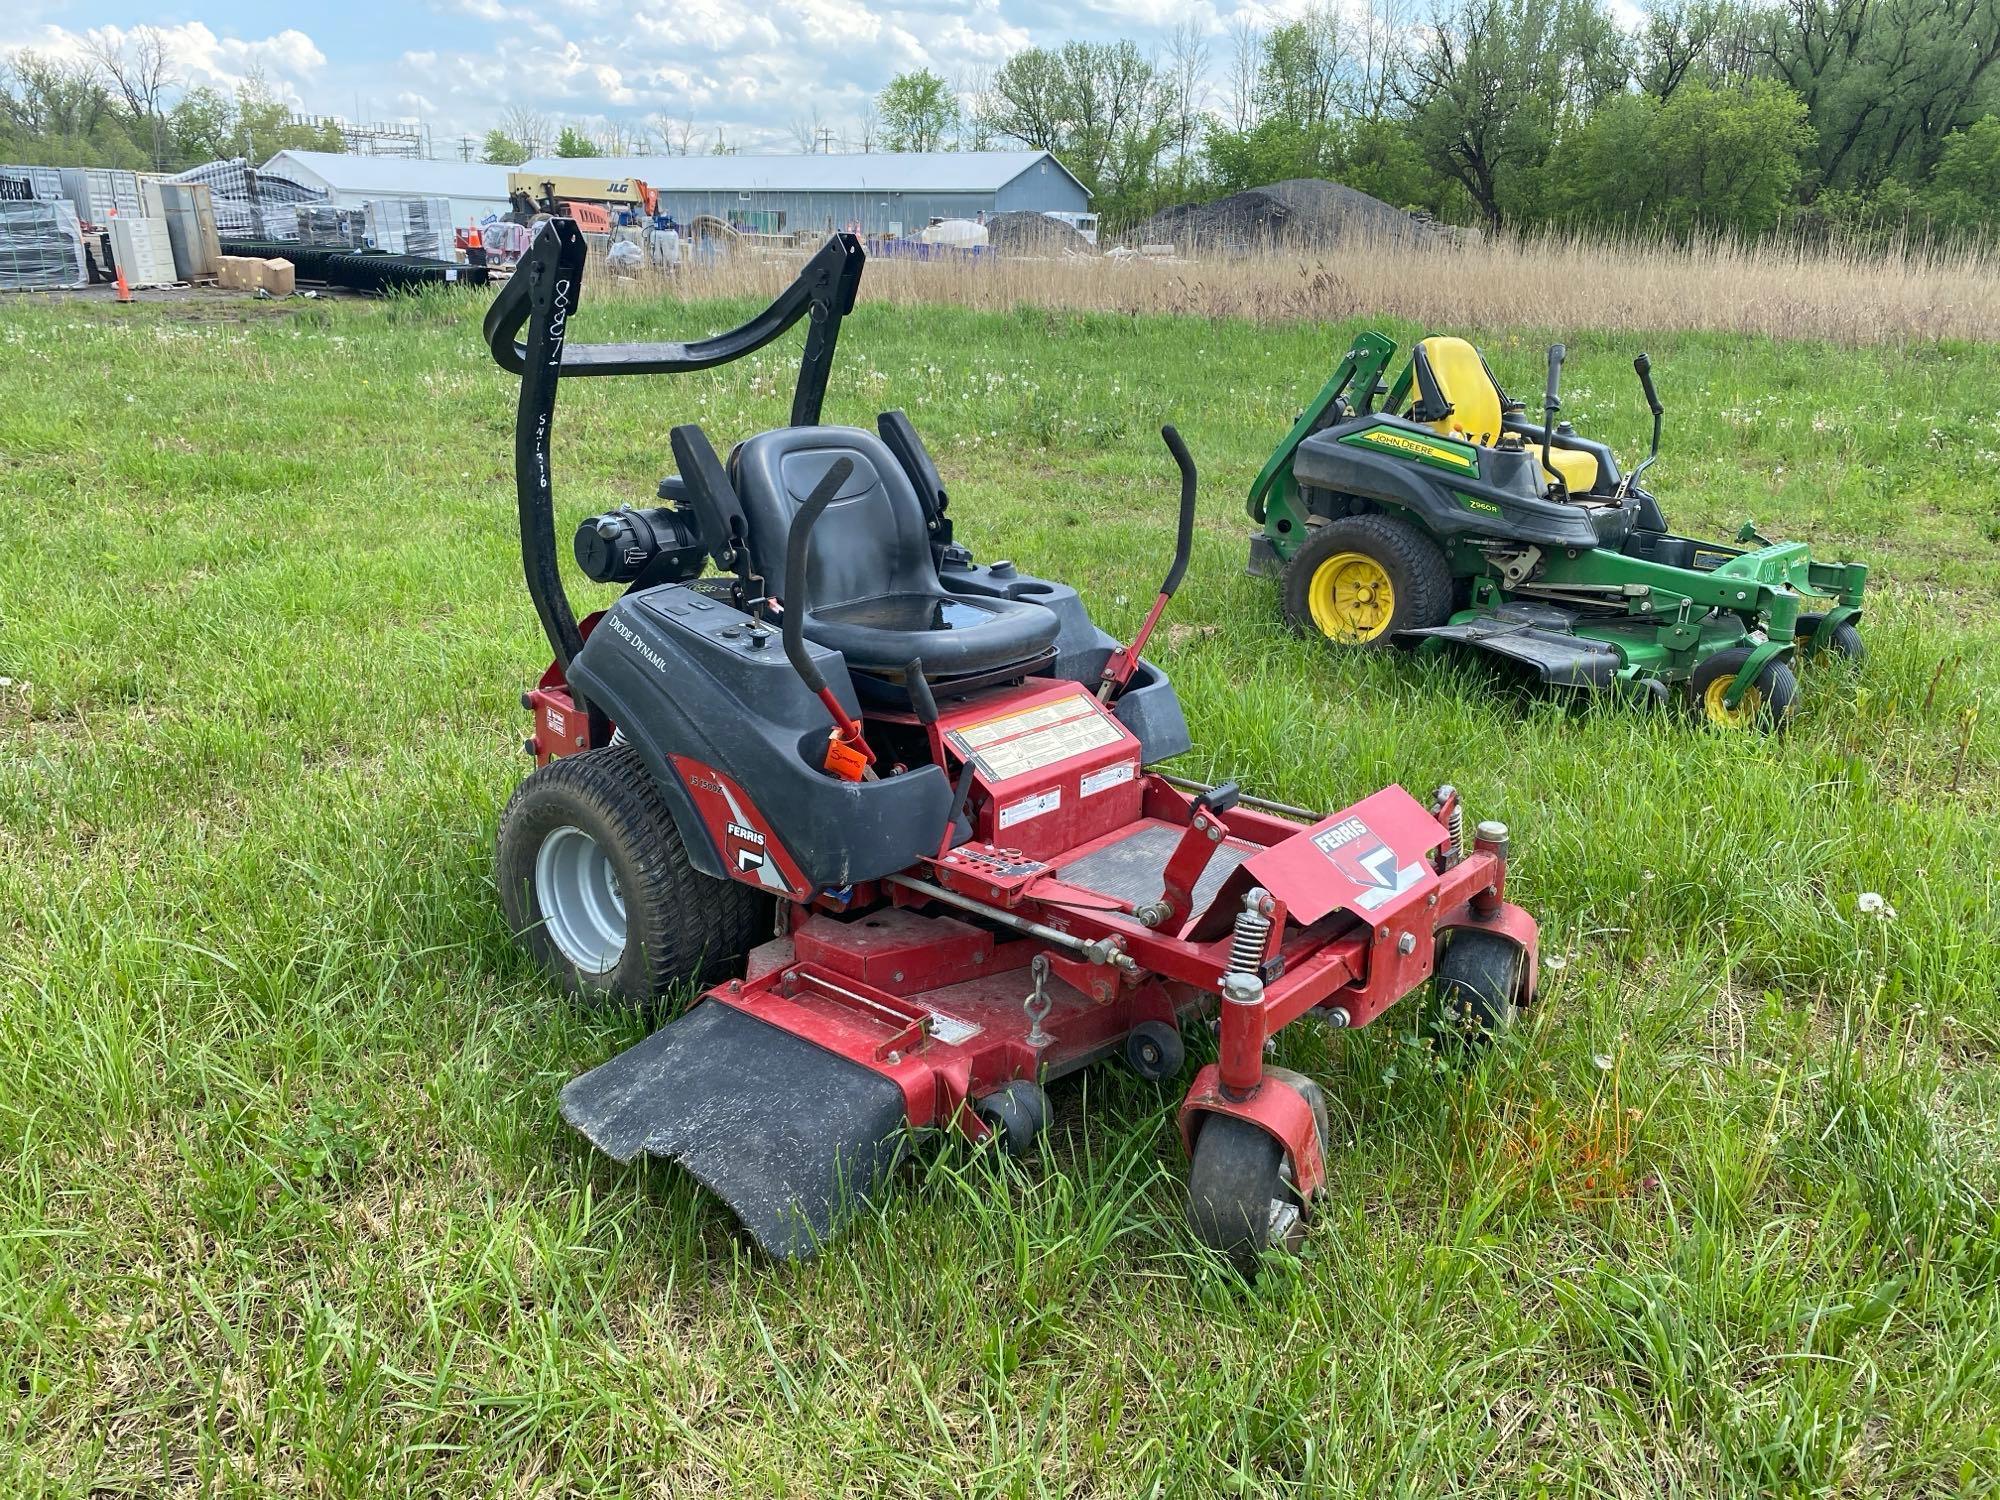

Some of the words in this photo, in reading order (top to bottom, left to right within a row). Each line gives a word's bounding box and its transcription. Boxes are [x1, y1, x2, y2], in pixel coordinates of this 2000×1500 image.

[606, 183, 629, 193] JLG
[1373, 433, 1400, 447] JOHN
[1401, 439, 1434, 455] DEERE
[608, 614, 633, 642] DIODE
[727, 823, 765, 846] FERRIS
[1313, 818, 1367, 853] FERRIS
